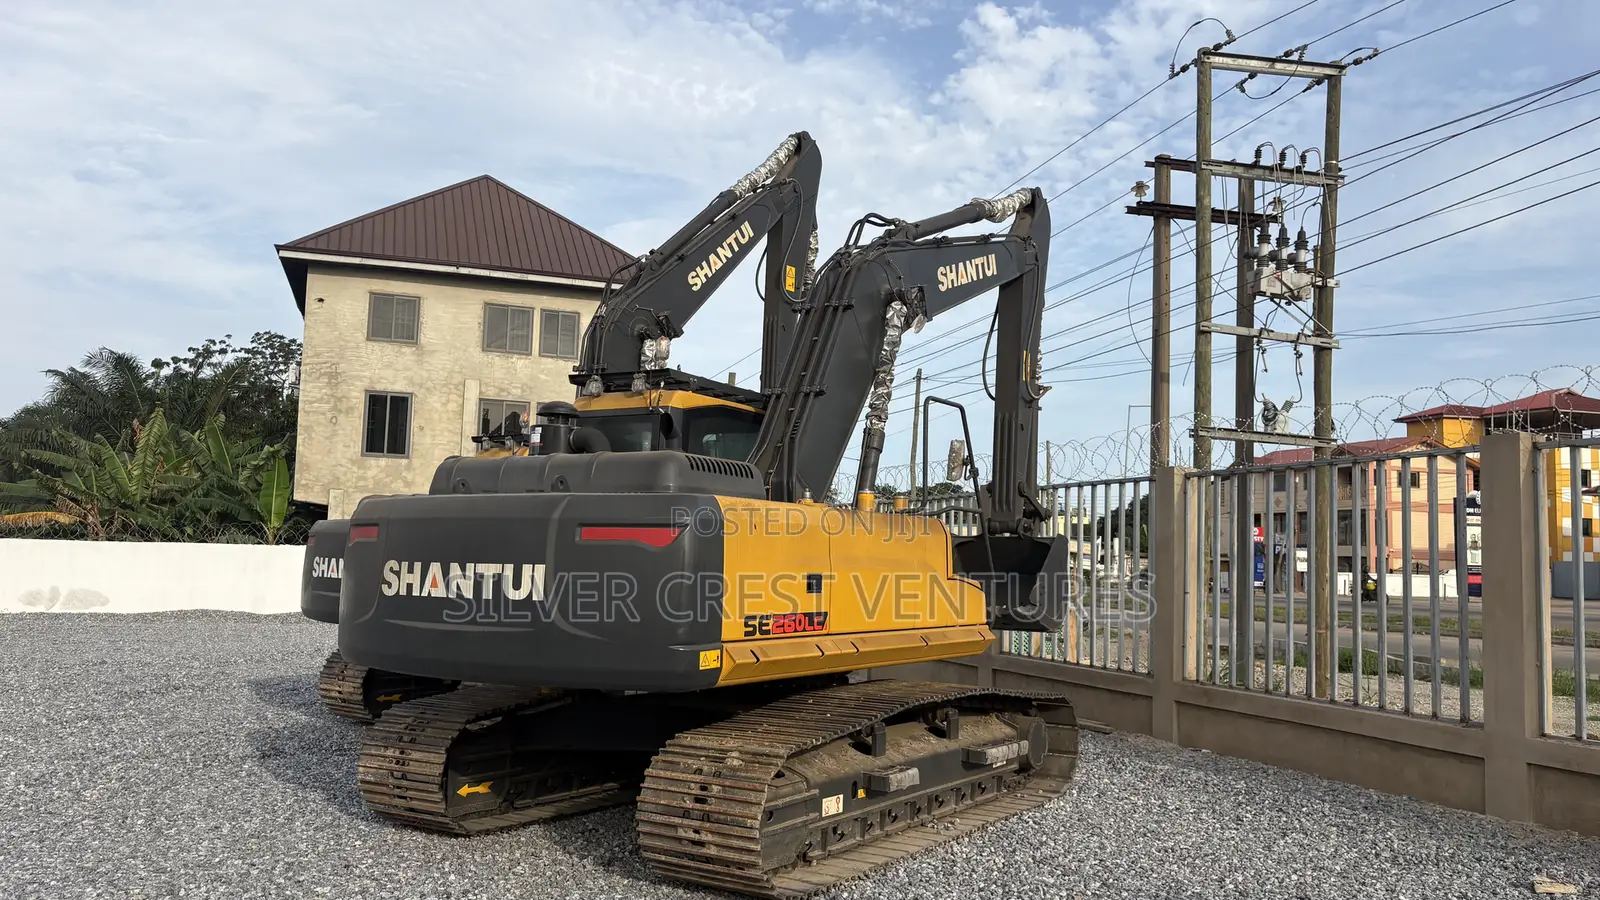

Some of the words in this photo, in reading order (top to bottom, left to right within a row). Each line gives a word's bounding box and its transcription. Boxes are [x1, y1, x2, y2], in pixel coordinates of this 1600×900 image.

[687, 220, 755, 292] SHANTUI
[937, 253, 998, 292] SHANTUI
[381, 559, 546, 601] SHANTUI
